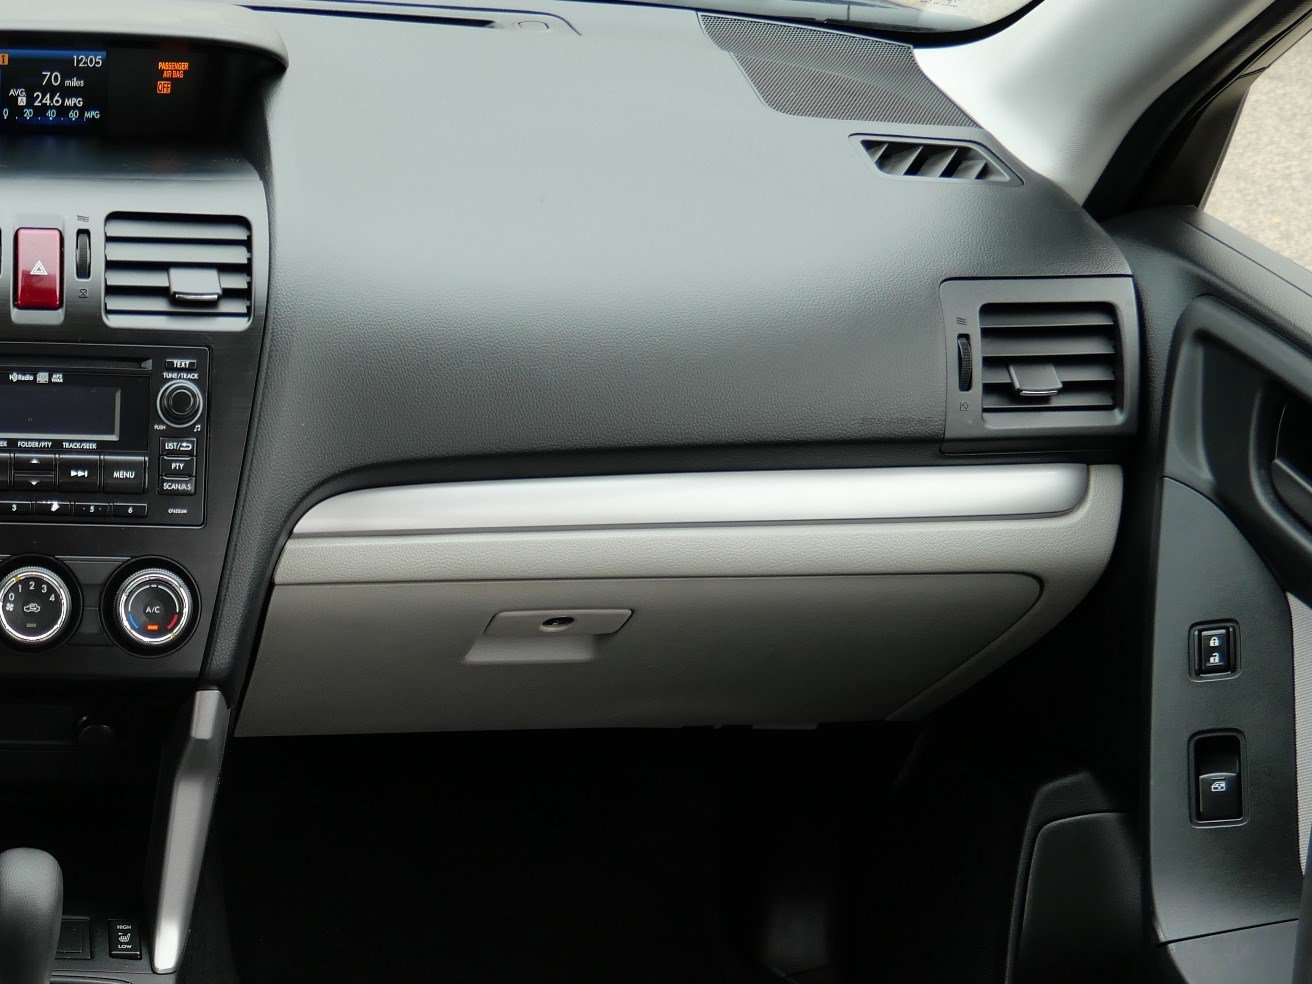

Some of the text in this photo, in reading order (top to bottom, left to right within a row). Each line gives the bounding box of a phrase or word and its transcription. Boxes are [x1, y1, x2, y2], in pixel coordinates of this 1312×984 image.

[73, 55, 102, 67] 12:05
[158, 61, 189, 70] PASSENGER
[163, 70, 184, 78] AIR BAG
[41, 72, 84, 87] 70 miles
[157, 81, 171, 93] OFF
[33, 92, 83, 107] 24.6 MPG
[3, 109, 100, 119] 0 20 40 60 MPG
[173, 361, 190, 369] TEXT
[163, 372, 199, 380] TUNE/TRACK
[63, 442, 97, 450] TRACK/SEEK
[113, 471, 135, 479] MENU
[11, 504, 17, 512] 3
[18, 584, 22, 593] 1
[29, 581, 35, 590] 2
[41, 584, 47, 593] 3
[8, 592, 15, 601] 0
[49, 593, 56, 602] 4
[145, 605, 160, 615] A/C
